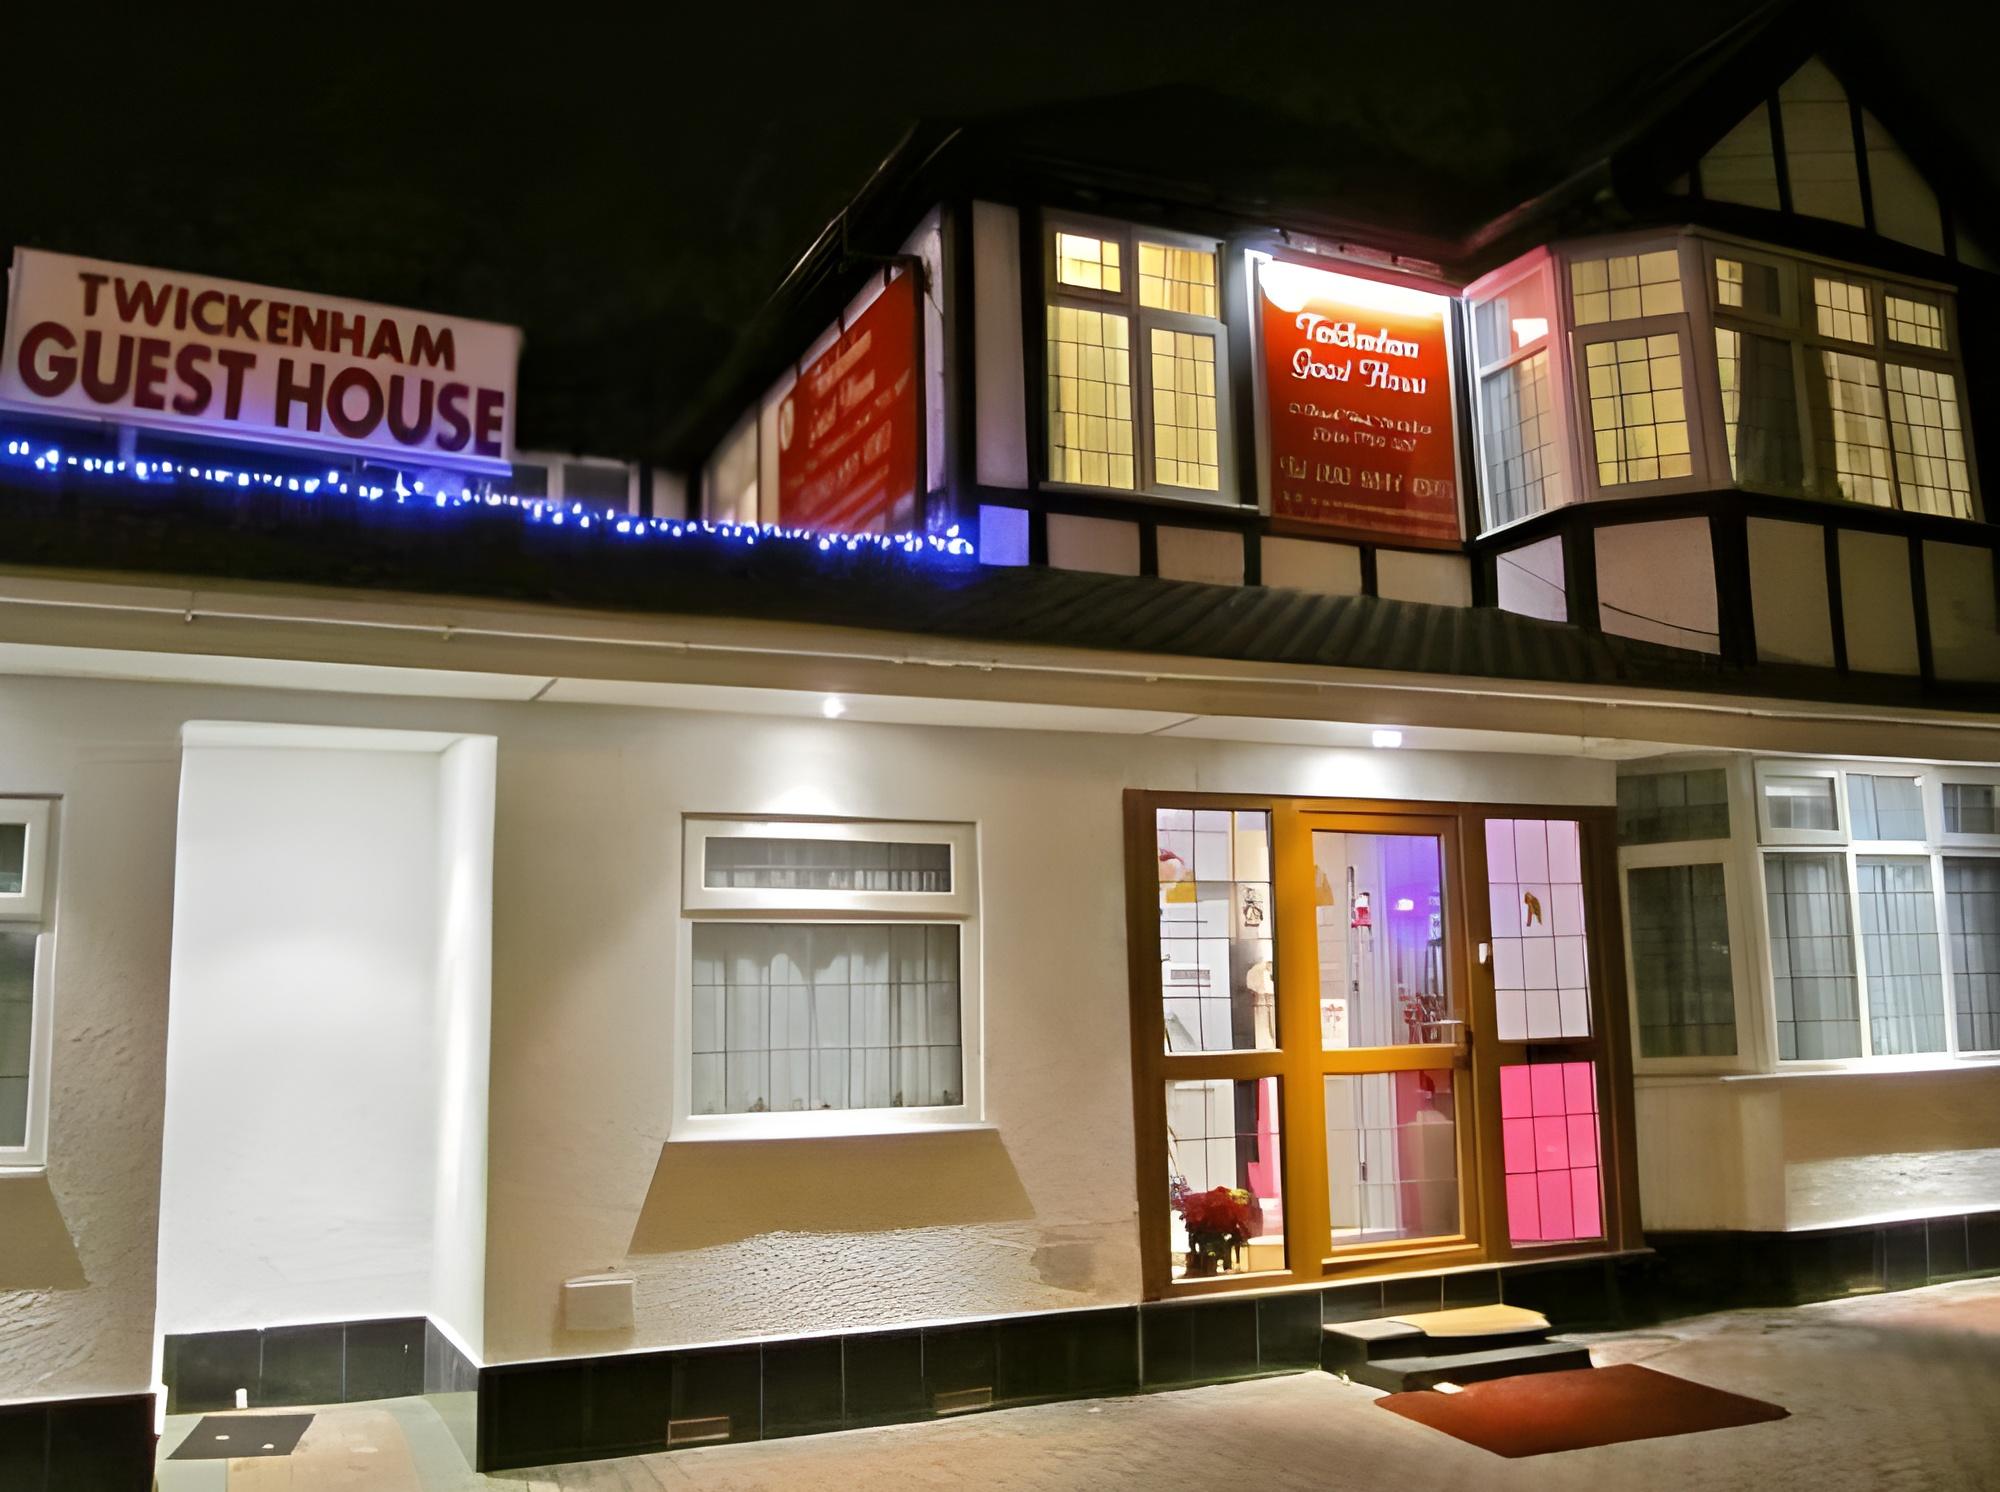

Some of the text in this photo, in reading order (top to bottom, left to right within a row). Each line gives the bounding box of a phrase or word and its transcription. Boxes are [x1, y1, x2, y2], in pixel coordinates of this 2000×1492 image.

[79, 272, 456, 371] TWICKENHAM
[18, 320, 505, 455] GUEST HOUSE
